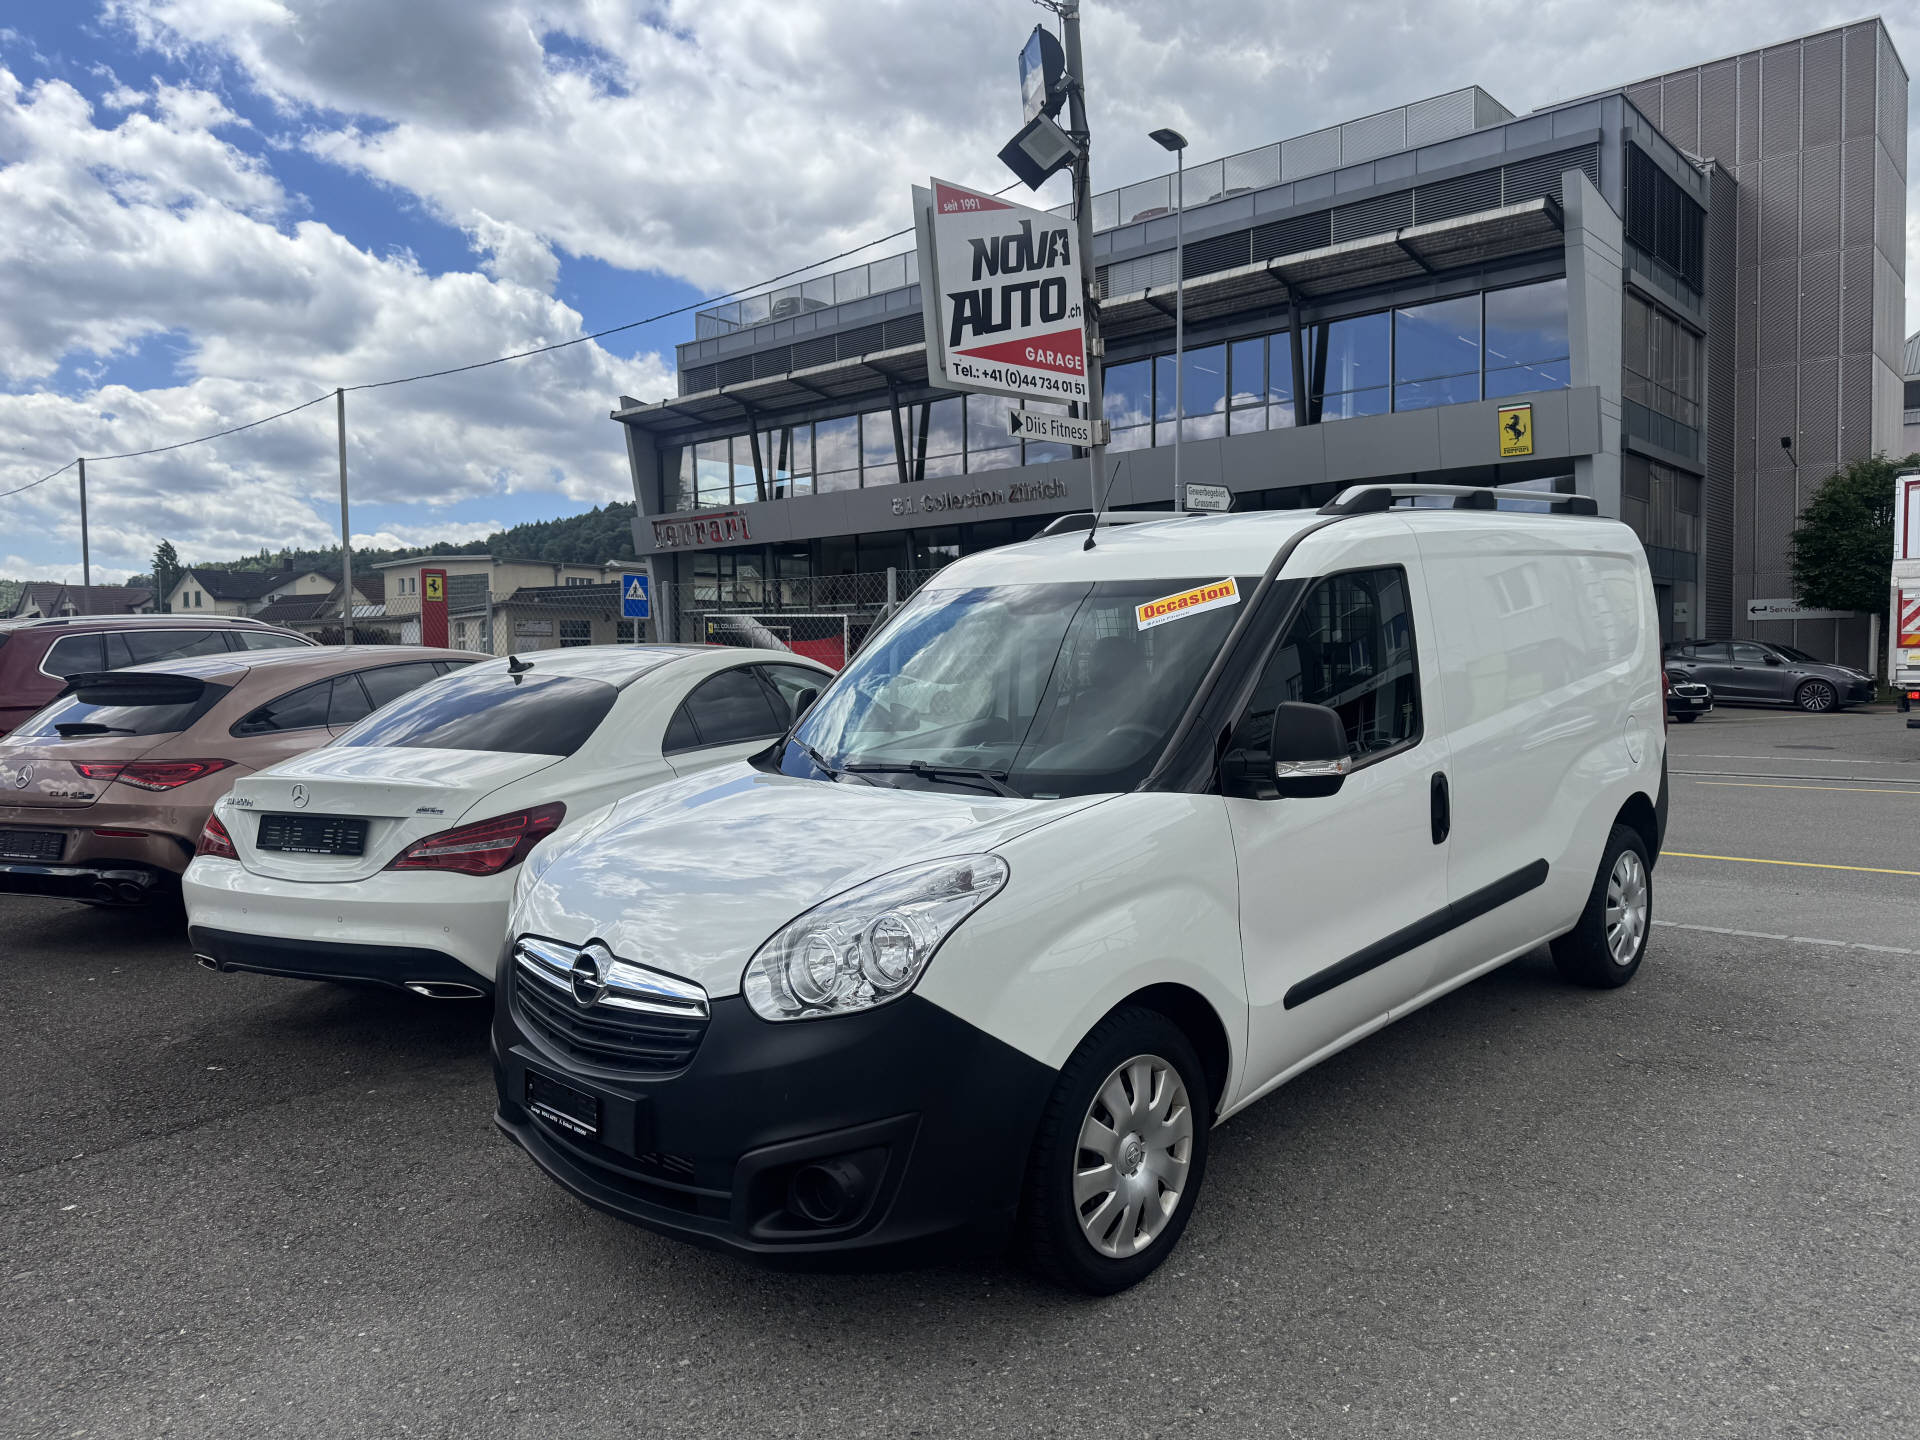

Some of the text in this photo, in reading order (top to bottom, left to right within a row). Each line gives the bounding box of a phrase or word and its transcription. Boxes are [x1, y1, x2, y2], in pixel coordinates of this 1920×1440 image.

[943, 198, 982, 211] seit 1991
[968, 220, 1071, 281] NOVA
[1025, 347, 1082, 370] GARAGE
[953, 363, 980, 379] Tel.:
[982, 369, 1003, 383] +41
[1039, 376, 1060, 392] 734
[1061, 380, 1073, 394] 01
[1075, 382, 1086, 396] 51
[1025, 415, 1088, 441] Diis Fitness
[920, 487, 1005, 514] Collection
[1008, 477, 1067, 504] Zürich
[652, 509, 751, 549] Ferrari
[1143, 585, 1231, 620] Occasion
[1769, 605, 1800, 613] Service
